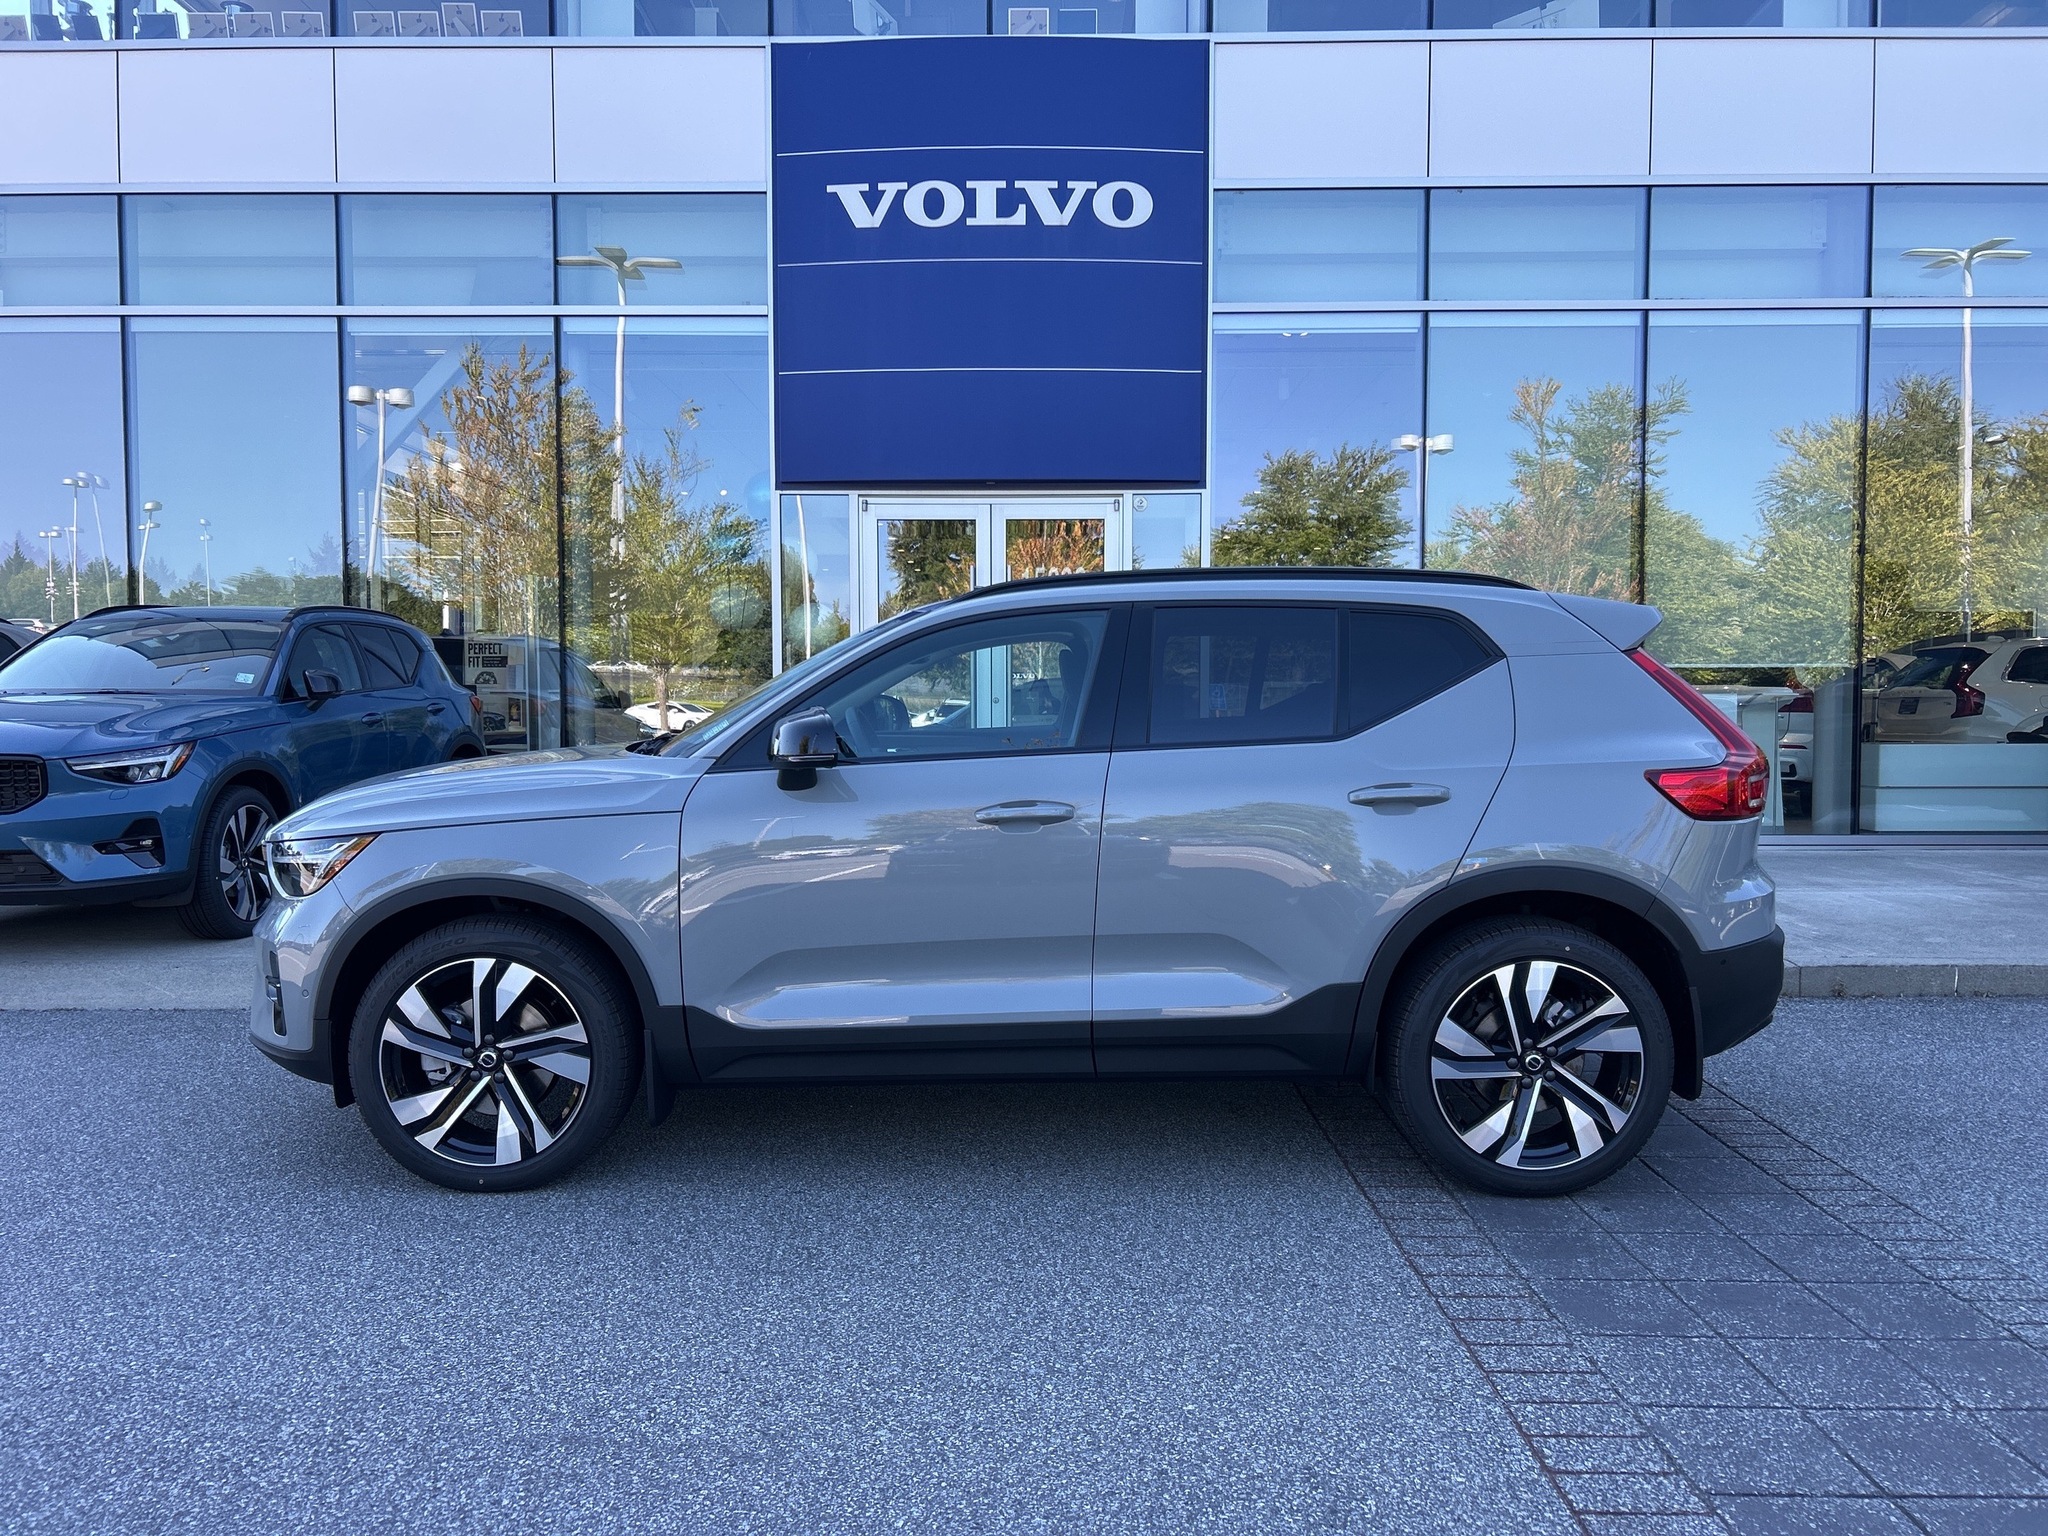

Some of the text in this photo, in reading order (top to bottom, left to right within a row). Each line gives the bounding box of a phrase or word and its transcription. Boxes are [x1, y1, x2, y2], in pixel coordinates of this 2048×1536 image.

[826, 180, 1154, 229] VOLVO
[468, 643, 502, 655] PERFECT
[468, 656, 480, 668] FIT
[419, 936, 467, 959] ZERO
